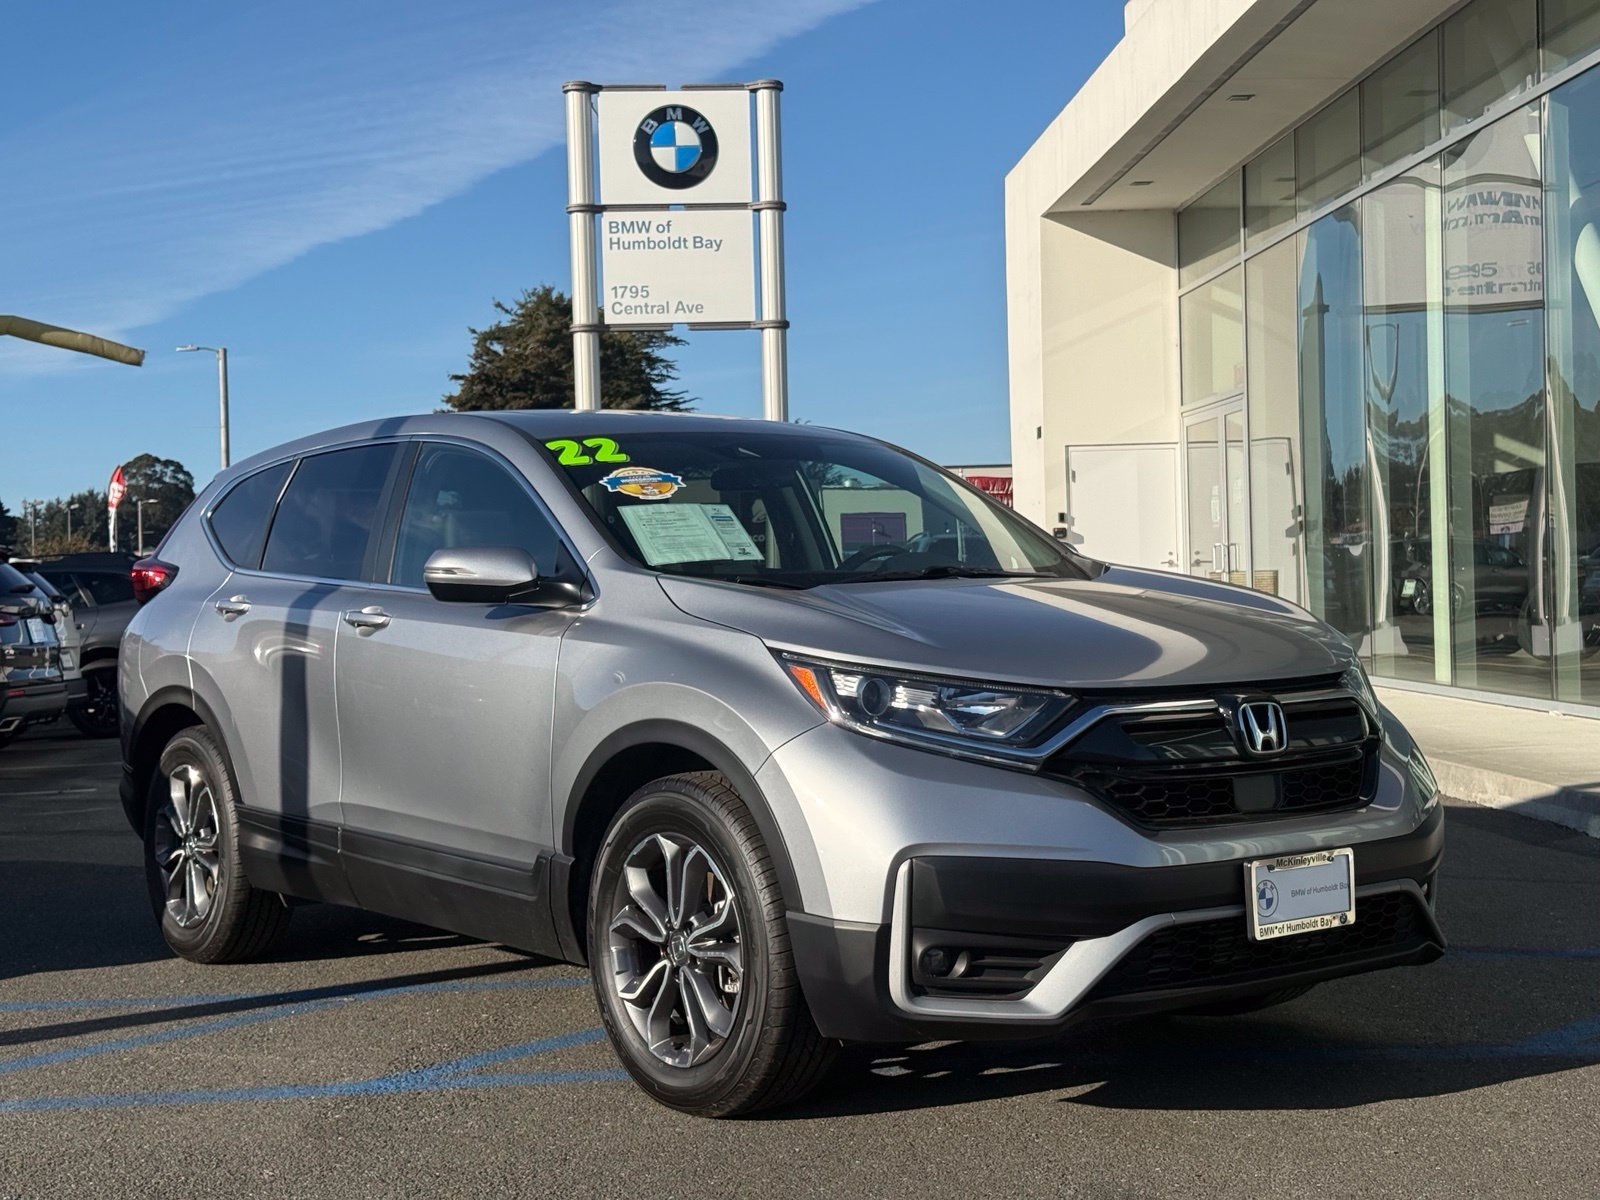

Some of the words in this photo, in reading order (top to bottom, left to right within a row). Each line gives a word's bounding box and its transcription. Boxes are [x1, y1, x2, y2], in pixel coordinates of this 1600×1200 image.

[640, 107, 710, 135] BMW
[608, 220, 652, 234] BMW
[656, 219, 672, 233] of
[609, 236, 689, 250] Humboldt
[693, 235, 723, 252] Bay
[611, 285, 650, 299] 1795
[611, 301, 670, 315] Central
[674, 300, 704, 314] Ave
[545, 437, 631, 466] 22
[1275, 853, 1327, 868] McKinleyville
[1290, 888, 1306, 898] BMW
[1306, 887, 1312, 895] of
[1312, 883, 1338, 894] Humboldt
[1286, 920, 1319, 932] Humboldt
